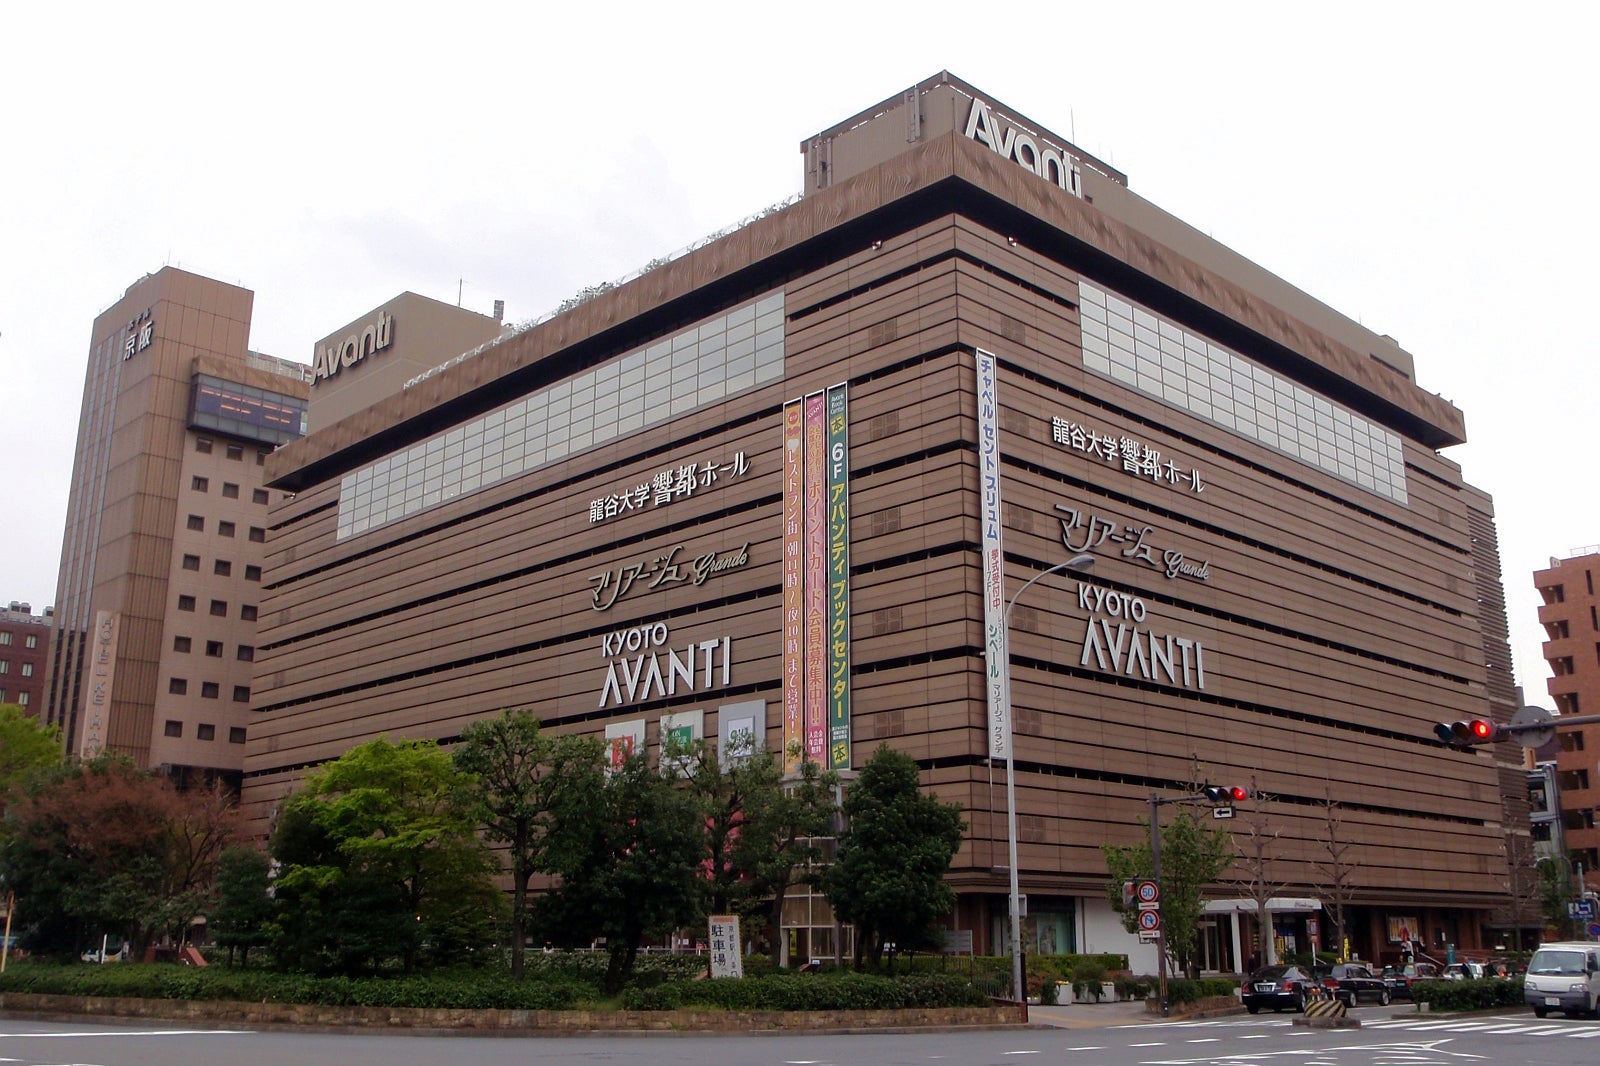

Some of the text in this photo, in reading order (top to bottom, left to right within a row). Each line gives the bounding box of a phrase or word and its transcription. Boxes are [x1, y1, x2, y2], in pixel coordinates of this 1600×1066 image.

[964, 97, 1082, 199] Avanti
[123, 320, 153, 361] 京阪
[310, 310, 393, 386] Avanti
[832, 442, 844, 479] 6F
[831, 483, 846, 575] アバンティ
[1055, 504, 1209, 579] マリアージュ Grande
[588, 542, 750, 611] マリアージュ Grande
[1079, 582, 1146, 622] KYOTO
[599, 636, 731, 707] AVANTI
[602, 622, 668, 658] KYOTO
[832, 579, 847, 718] ブックセンター
[1080, 615, 1204, 689] AVANTI
[1142, 887, 1153, 897] 50
